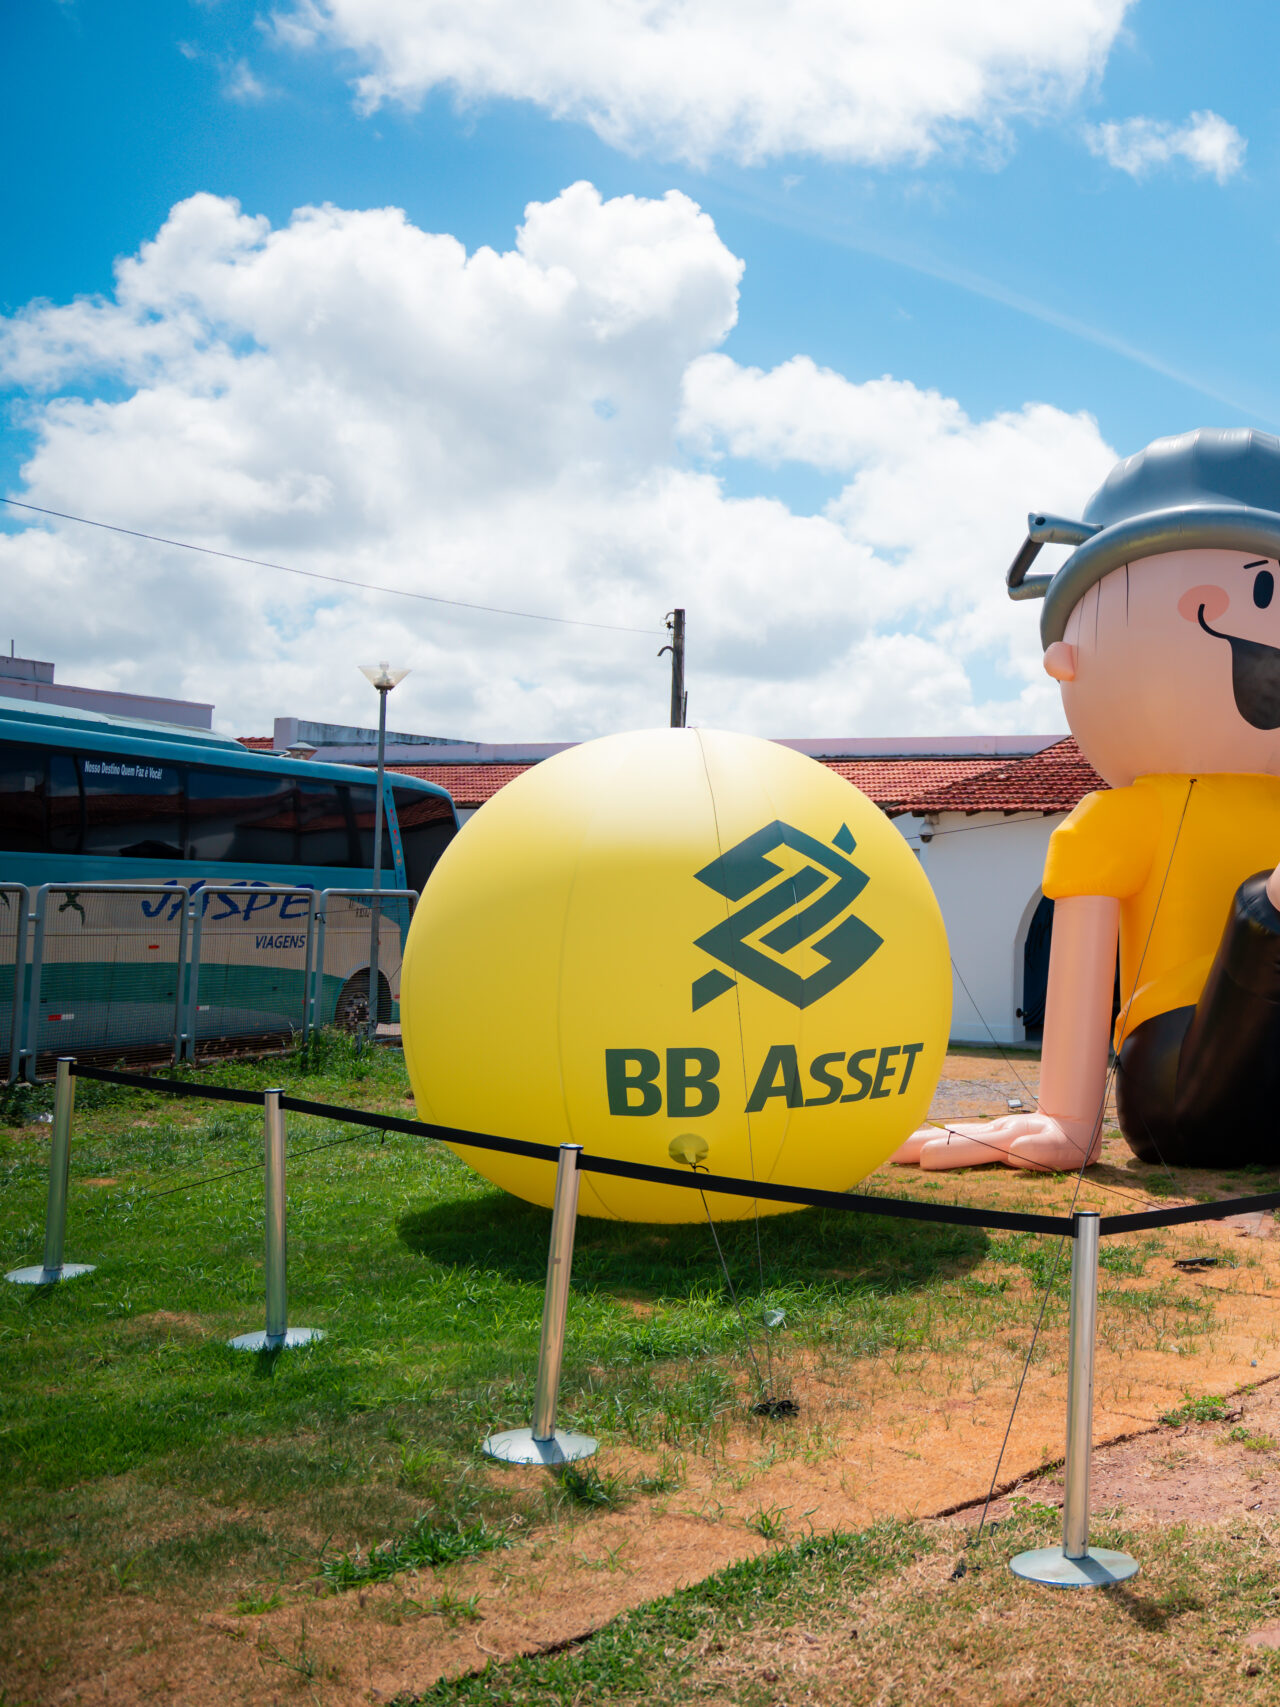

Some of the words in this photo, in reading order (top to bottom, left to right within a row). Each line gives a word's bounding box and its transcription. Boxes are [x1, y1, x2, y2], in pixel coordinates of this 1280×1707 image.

[85, 761, 100, 773] Nosso
[101, 762, 120, 775] Destino
[121, 764, 134, 776] Quem
[136, 765, 144, 777] Faz
[149, 767, 162, 780] Você!
[141, 880, 314, 921] JASPE
[255, 935, 306, 949] VIAGENS
[605, 1047, 721, 1118] BB
[744, 1043, 924, 1114] ASSET
